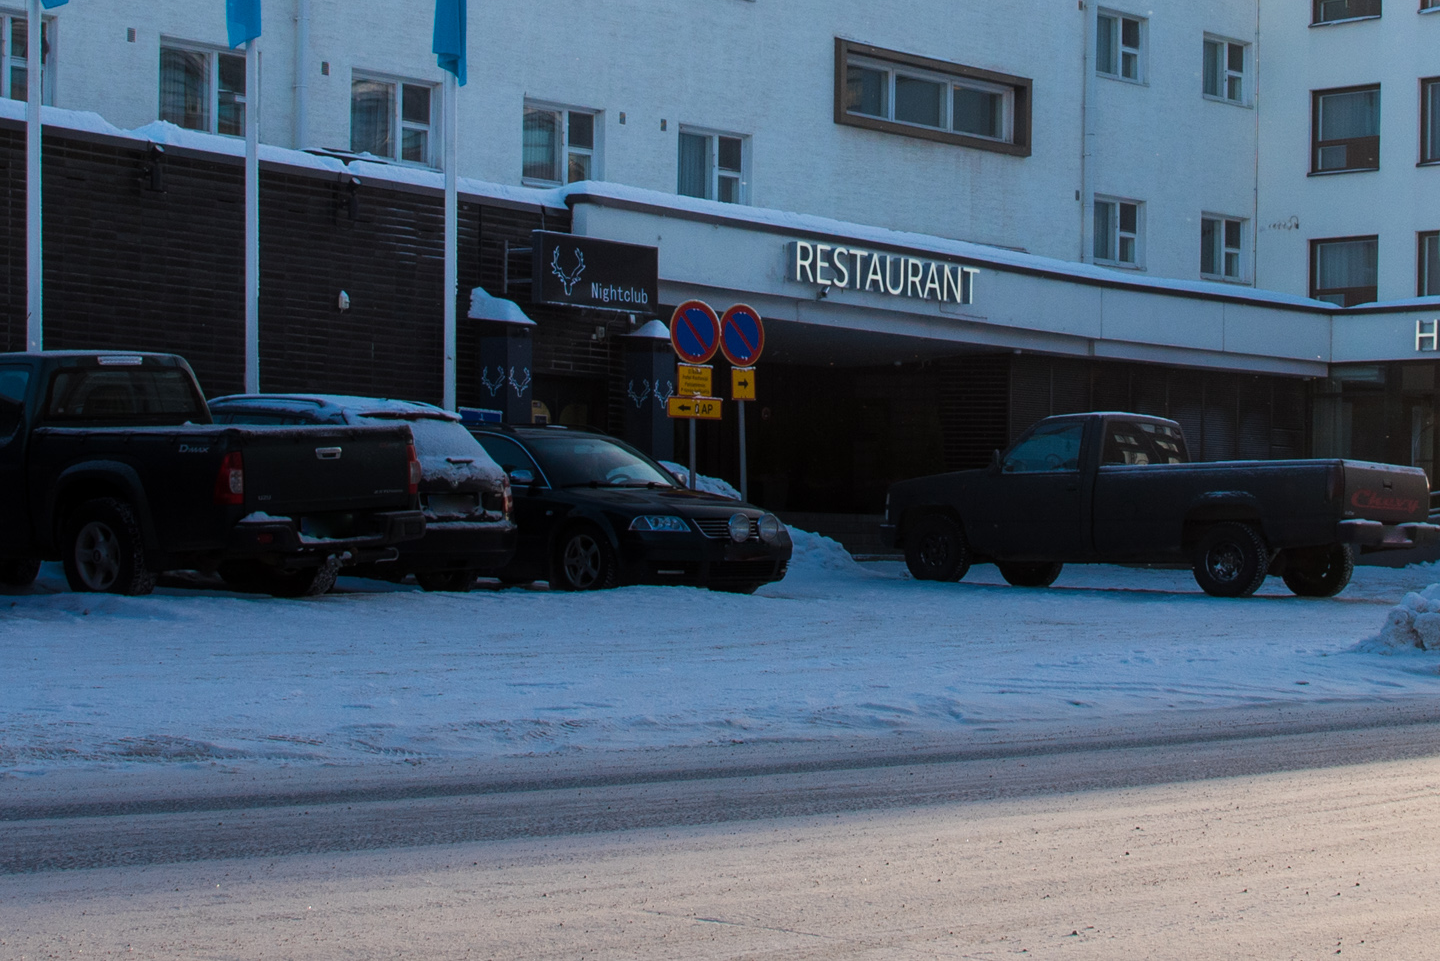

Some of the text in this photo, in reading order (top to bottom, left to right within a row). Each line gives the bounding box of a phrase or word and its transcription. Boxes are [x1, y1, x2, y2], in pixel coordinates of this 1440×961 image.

[796, 240, 980, 305] RESTAURANT
[591, 282, 648, 304] Nightclub
[701, 403, 713, 414] AP
[1351, 488, 1420, 513] Chevy
